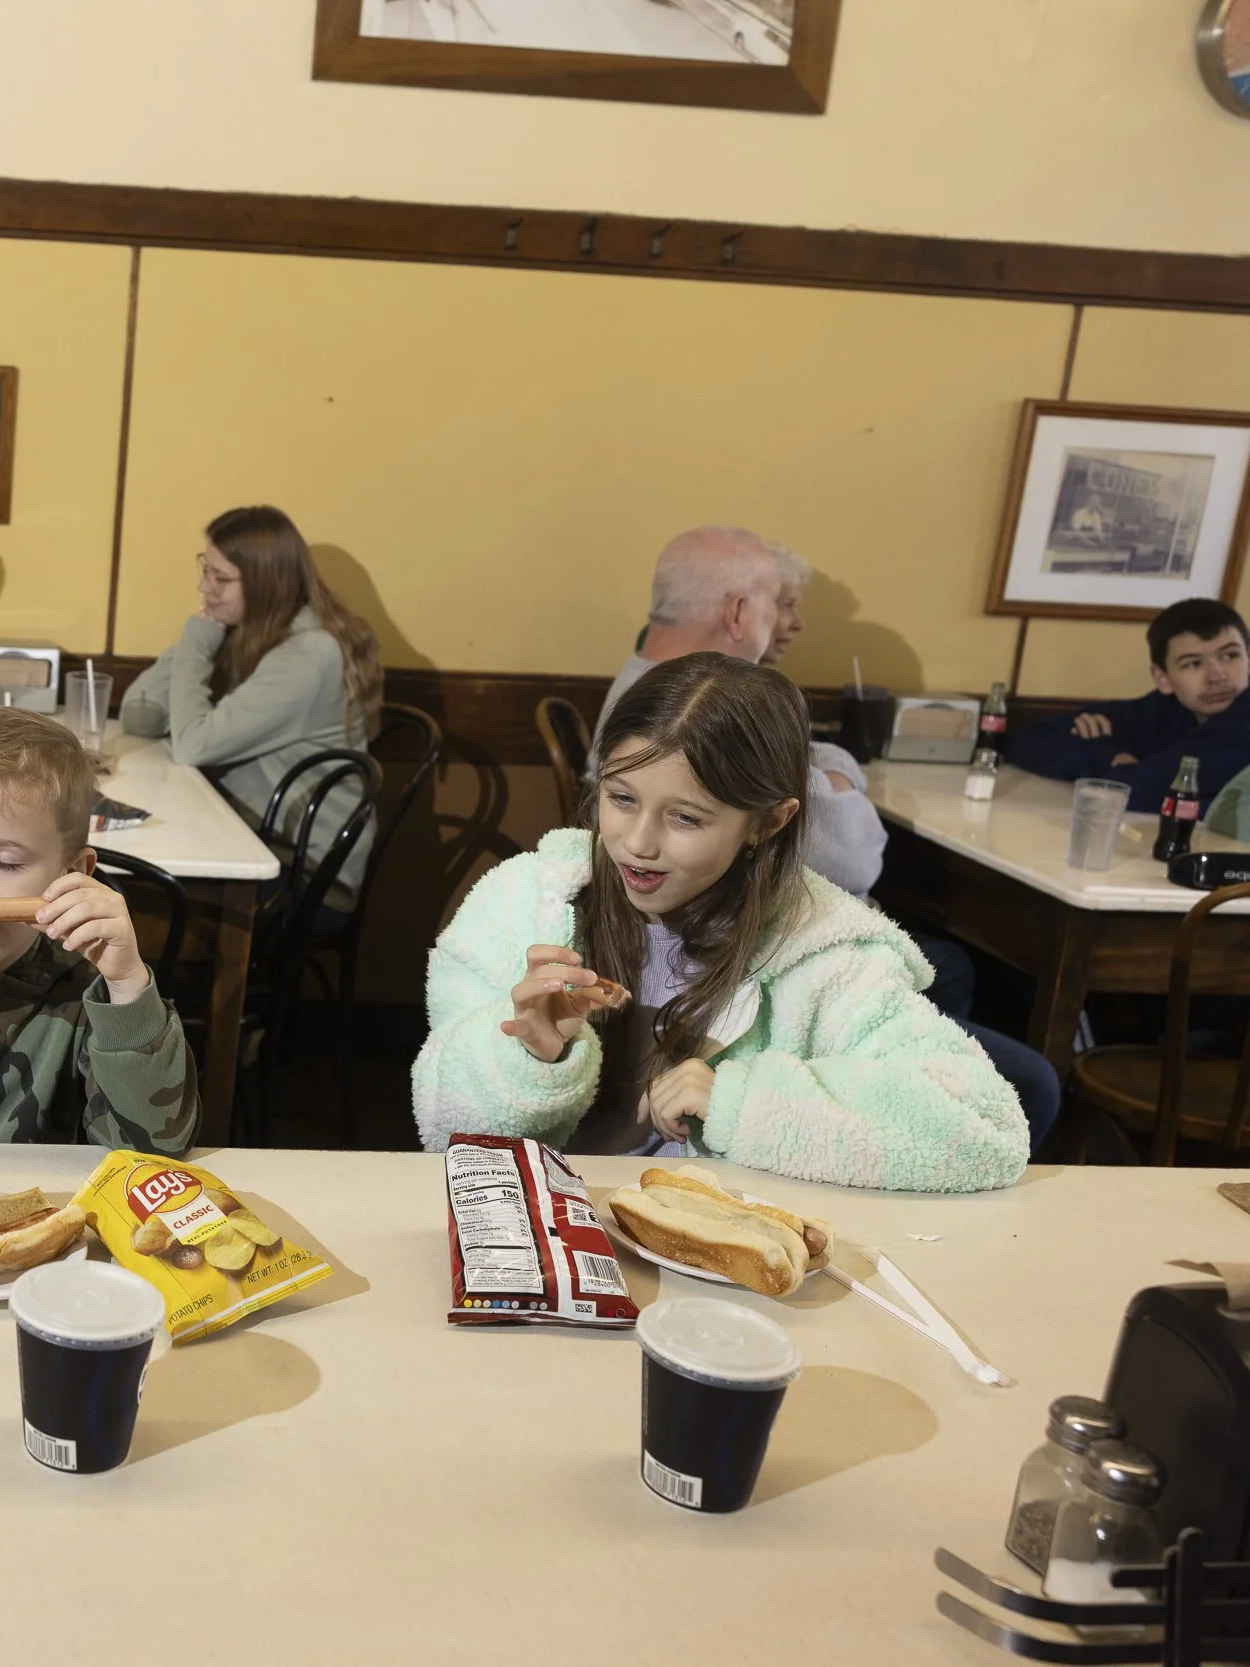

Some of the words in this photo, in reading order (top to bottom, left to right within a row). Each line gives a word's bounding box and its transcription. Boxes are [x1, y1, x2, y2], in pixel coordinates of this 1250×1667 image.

[452, 1170, 490, 1181] Nutrition
[131, 1169, 193, 1213] Lay's
[456, 1194, 488, 1205] Calories
[501, 1189, 519, 1199] 150
[173, 1205, 214, 1229] CLASSIC
[247, 1273, 261, 1284] NET
[261, 1266, 274, 1277] WT.
[168, 1303, 194, 1325] POTATO
[192, 1293, 214, 1311] CHIPS
